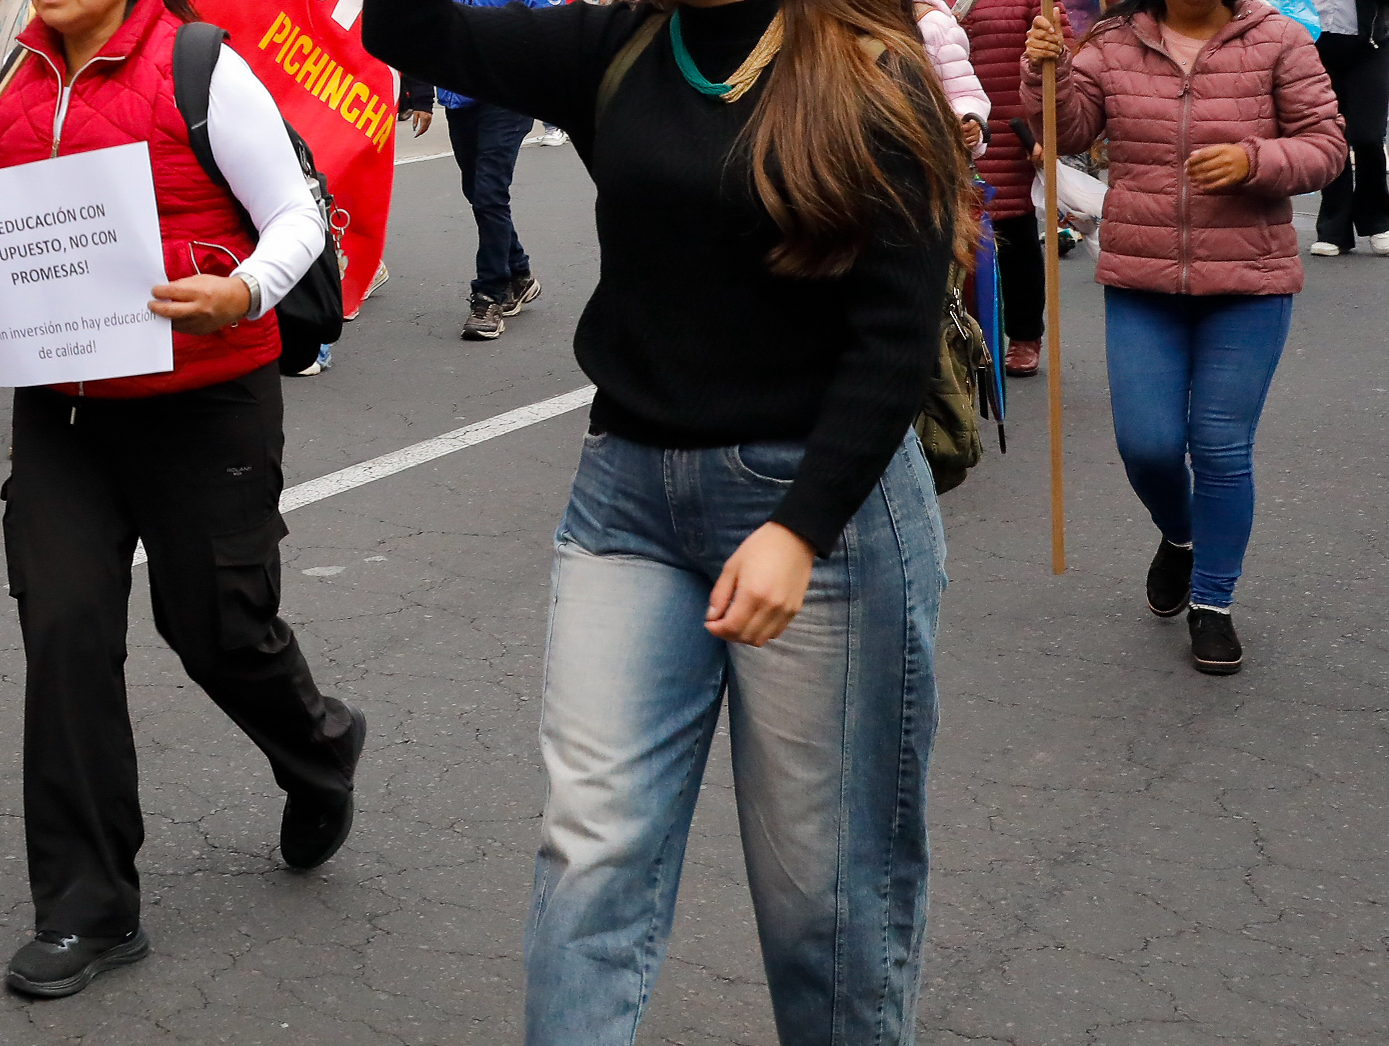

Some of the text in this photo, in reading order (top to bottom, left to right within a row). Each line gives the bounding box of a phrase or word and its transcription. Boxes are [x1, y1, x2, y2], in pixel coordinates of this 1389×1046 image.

[258, 11, 395, 154] PICHINCHA
[80, 203, 106, 220] CON
[69, 234, 89, 249] NO
[91, 229, 118, 246] CON
[11, 260, 91, 286] PROMESAS!
[10, 320, 62, 340] inversión
[65, 319, 79, 331] no
[81, 315, 101, 332] hay
[103, 309, 157, 328] educación
[38, 340, 97, 360] de calidad!
